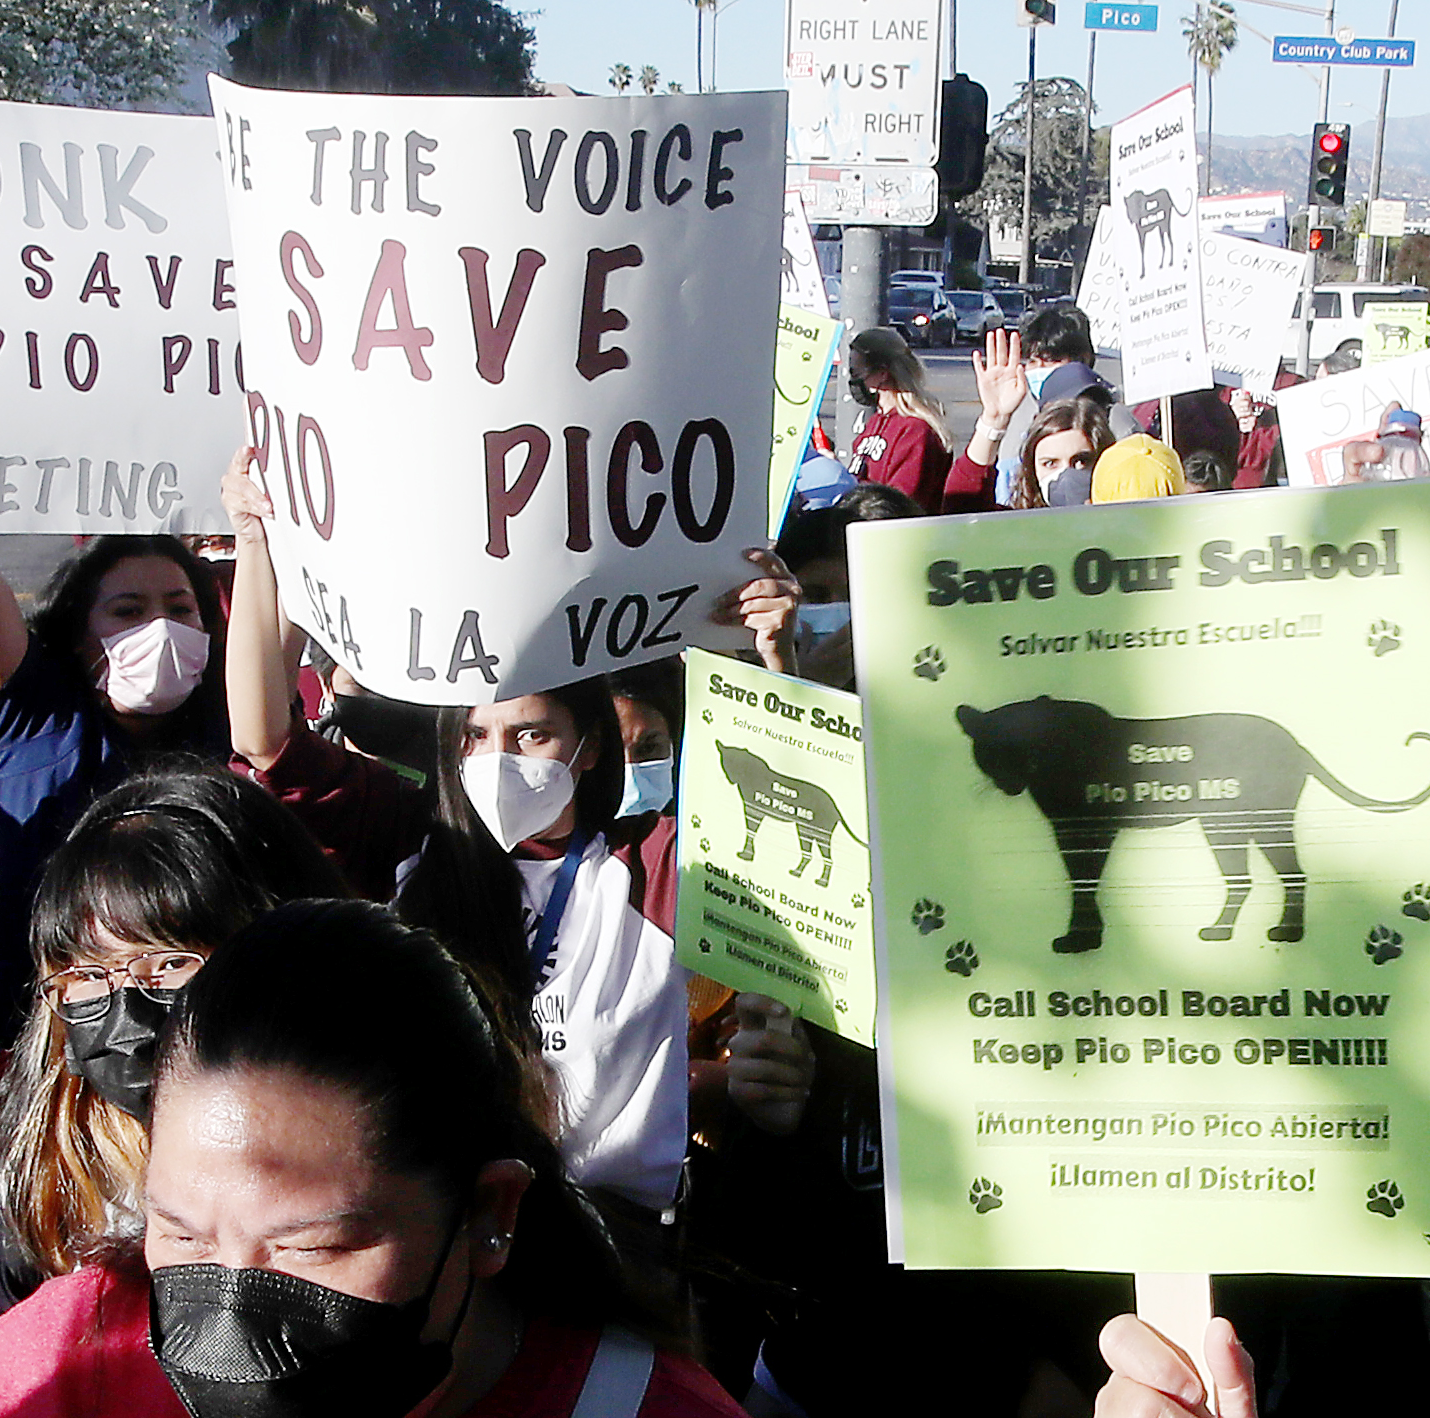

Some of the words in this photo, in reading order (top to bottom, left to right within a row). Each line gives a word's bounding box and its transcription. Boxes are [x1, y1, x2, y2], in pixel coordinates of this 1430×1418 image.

[800, 20, 859, 40] RIGHT
[873, 20, 928, 40] LANE
[1101, 8, 1140, 26] Pico
[1278, 43, 1334, 60] Country
[1341, 45, 1371, 59] Club
[1376, 46, 1408, 61] Park
[865, 113, 924, 133] RIGHT
[306, 126, 441, 216] THE
[513, 123, 744, 216] VOICE
[21, 245, 236, 310] SAVE
[1227, 249, 1298, 279] CONTRA
[280, 230, 644, 385] SAVE
[163, 335, 244, 394] PI
[246, 390, 335, 541] PIO
[483, 417, 736, 559] PICO
[927, 559, 1056, 607] Save
[1073, 547, 1180, 597] Our
[1198, 528, 1400, 587] School
[303, 566, 362, 670] SEA
[407, 607, 499, 684] LA
[566, 584, 699, 666] VOZ
[999, 632, 1080, 657] Salvar
[1086, 623, 1188, 652] Nuestra
[1198, 613, 1323, 645] Escuela!!!
[710, 674, 757, 707] Save
[767, 692, 805, 722] Our
[812, 710, 861, 741] Scho
[733, 718, 761, 735] Salvar
[766, 728, 803, 748] Nuestra
[1127, 742, 1195, 764] Save
[1085, 783, 1128, 803] Pio
[1133, 780, 1193, 802] Pico
[1197, 777, 1241, 800] MS
[705, 880, 736, 906] Keep
[741, 894, 759, 913] Pio
[765, 905, 791, 928] Pico
[706, 863, 728, 882] Call
[731, 871, 775, 899] School
[780, 894, 818, 919] Board
[823, 908, 856, 929] Now
[969, 990, 1035, 1018] Call
[1049, 989, 1168, 1018] School
[1182, 989, 1291, 1018] Board
[1305, 990, 1391, 1018] Now
[973, 1038, 1064, 1071] Keep
[1075, 1037, 1130, 1065] Pio
[1143, 1037, 1221, 1066] Pico
[1234, 1038, 1389, 1066] OPEN!!!!
[977, 1110, 1143, 1141] ¡Mantengan
[1151, 1113, 1194, 1137] Pio
[1204, 1113, 1261, 1138] Pico
[1270, 1113, 1390, 1141] Abierta!
[1050, 1163, 1157, 1190] ¡Llamen
[1165, 1165, 1190, 1190] al
[1198, 1166, 1316, 1192] Distrito!
